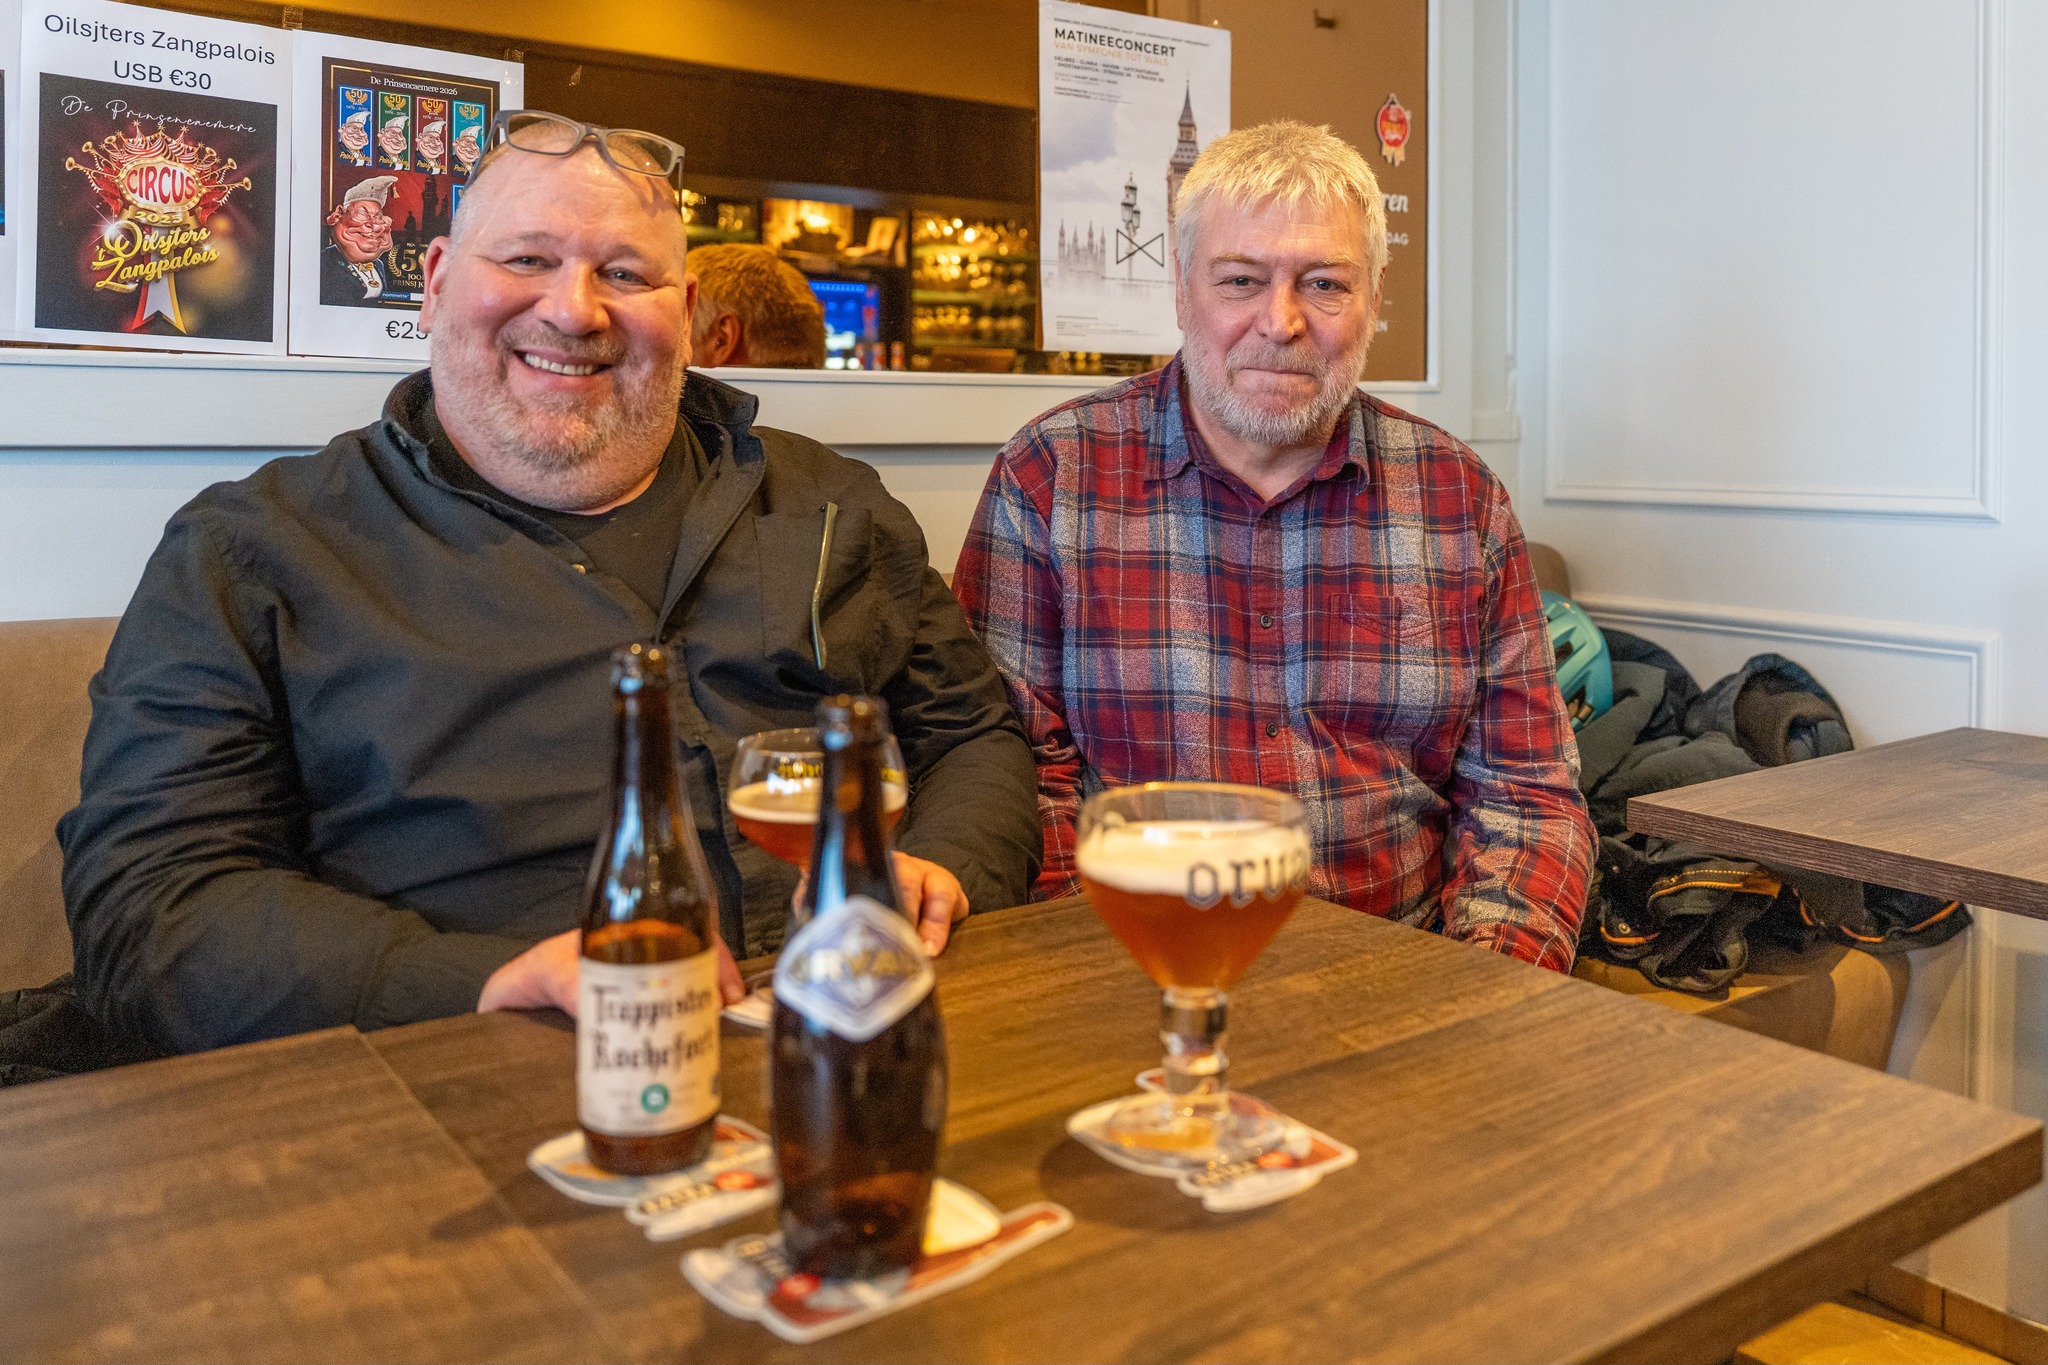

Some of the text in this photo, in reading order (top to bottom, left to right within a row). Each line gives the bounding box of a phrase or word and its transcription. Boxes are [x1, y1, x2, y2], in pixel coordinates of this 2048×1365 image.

[44, 14, 276, 65] Oilsjters Zangpalois
[1055, 27, 1176, 57] MATINEECONCERT
[1054, 41, 1169, 66] VAN SYMFONIE TOT WALS
[113, 60, 212, 90] USB €30
[370, 76, 458, 96] De Prinsencaemere 2026
[351, 88, 363, 99] 50
[390, 93, 401, 104] 50
[428, 98, 439, 109] 50
[61, 95, 94, 116] De
[464, 103, 475, 114] 50
[126, 166, 196, 204] CIRCUS
[103, 220, 211, 258] Oilsjters
[91, 246, 220, 290] Zangpalois
[385, 320, 428, 340] €25
